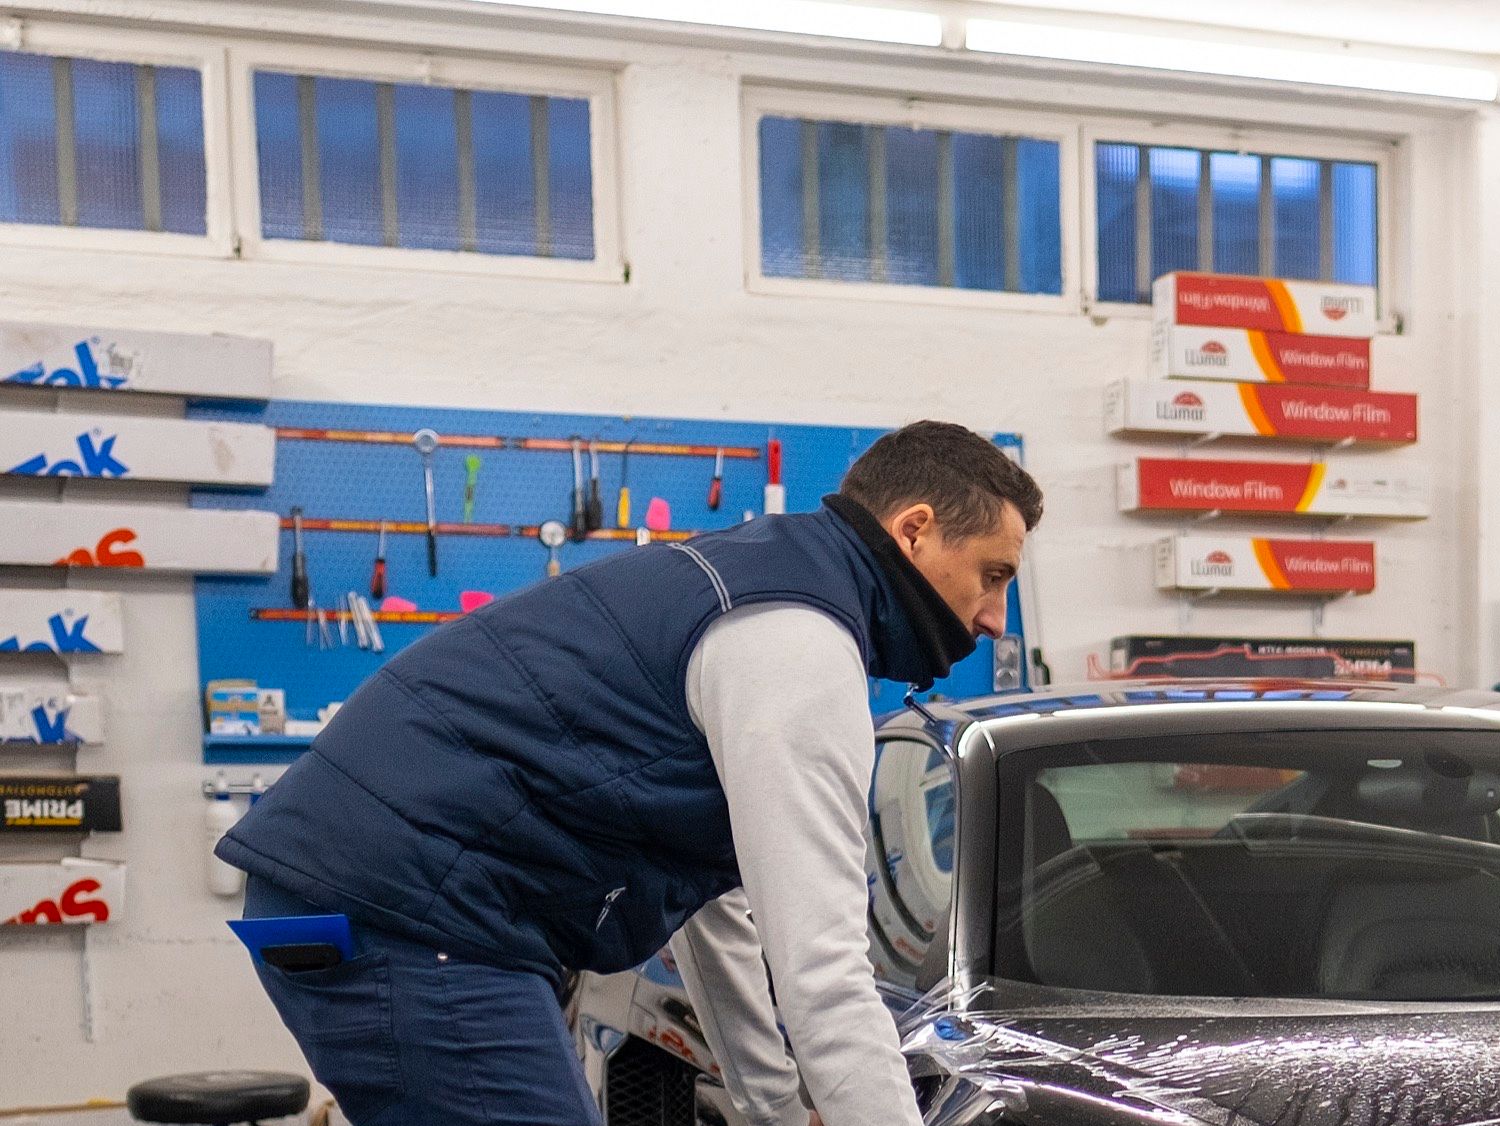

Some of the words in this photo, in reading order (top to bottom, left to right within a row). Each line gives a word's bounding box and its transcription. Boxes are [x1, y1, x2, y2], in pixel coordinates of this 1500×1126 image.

[1179, 292, 1211, 309] Film
[1213, 294, 1270, 312] Window
[1280, 350, 1333, 368] Window
[1336, 352, 1367, 368] Film
[1281, 400, 1349, 421] Window
[1352, 403, 1391, 423] Film
[1169, 479, 1241, 499] Window
[1243, 481, 1284, 500] Film
[1284, 557, 1339, 572] Window
[1340, 558, 1371, 573] Film
[4, 799, 83, 818] PRIME
